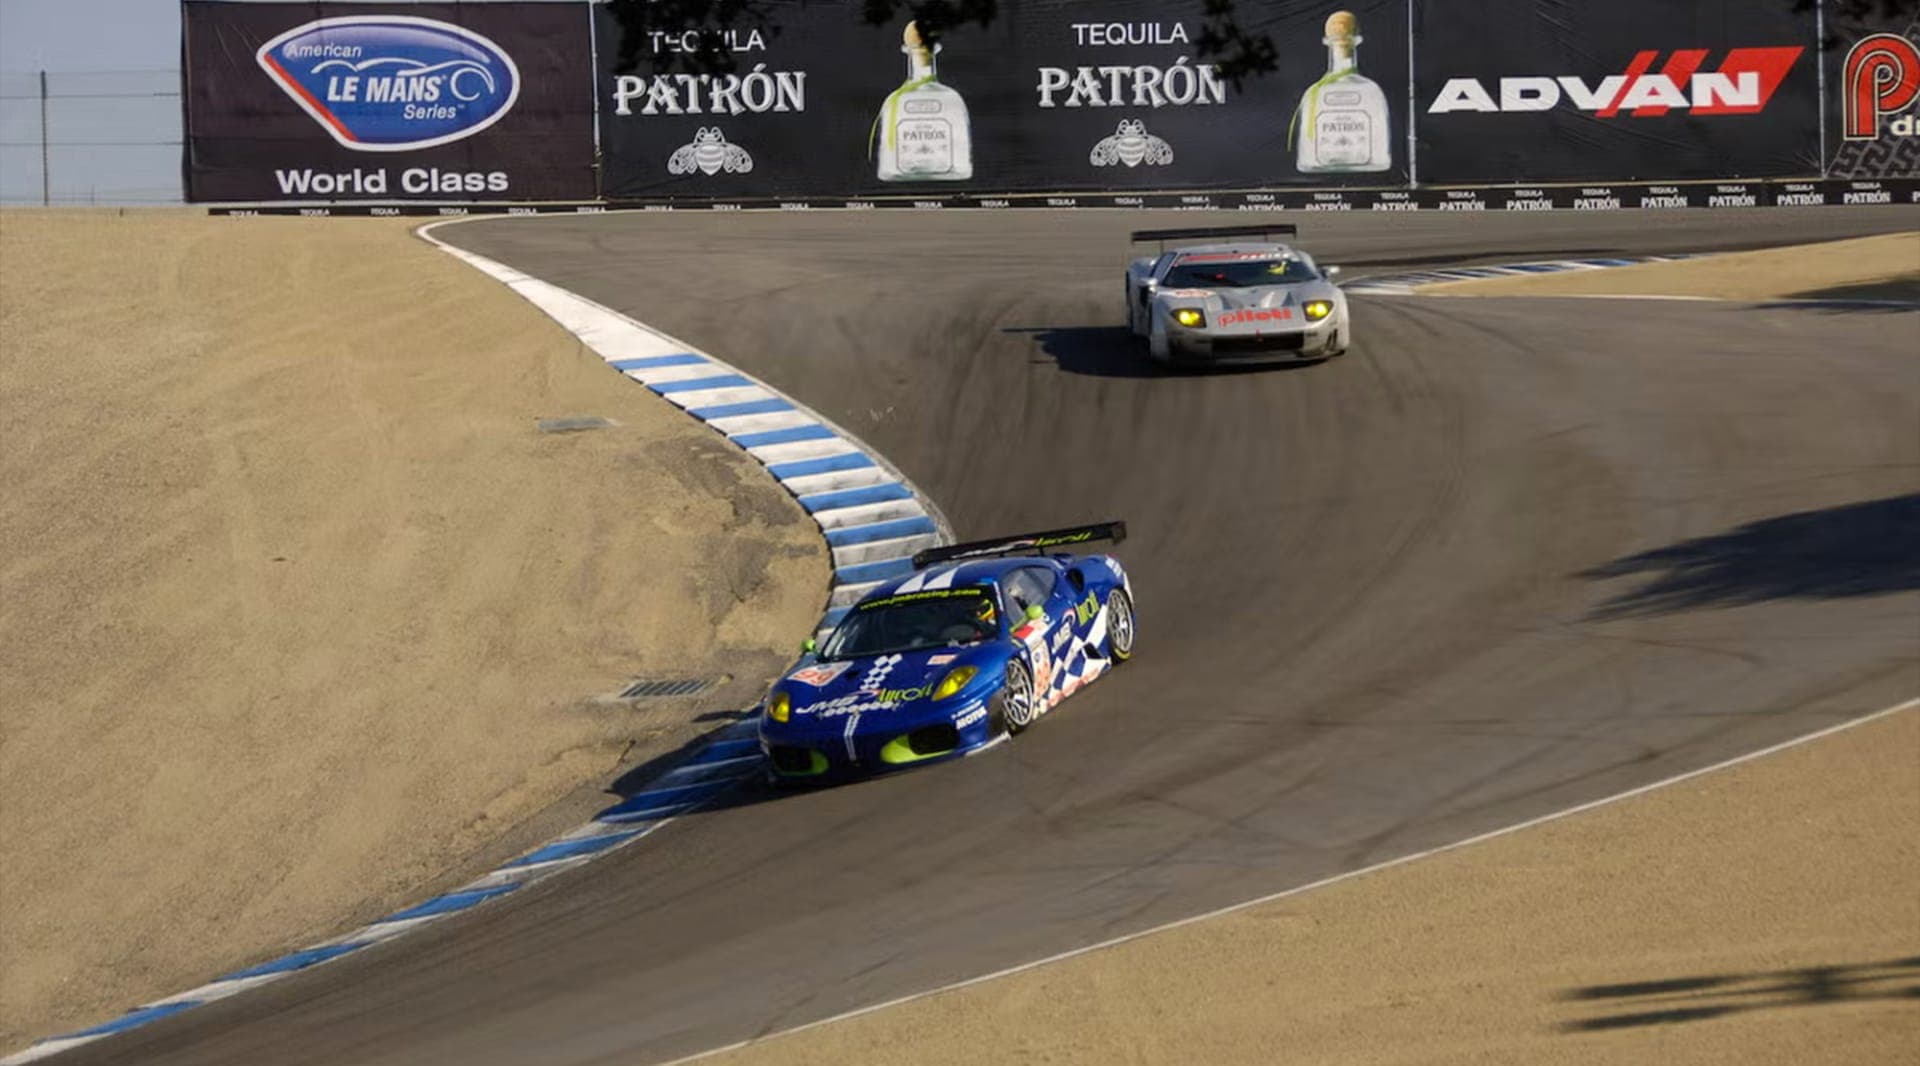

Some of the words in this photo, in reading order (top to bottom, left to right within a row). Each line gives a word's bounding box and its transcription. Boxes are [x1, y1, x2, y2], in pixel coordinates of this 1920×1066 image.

[647, 29, 767, 53] TEQILA
[1071, 22, 1189, 46] TEQUILA
[286, 43, 363, 59] American
[327, 76, 361, 102] LE
[364, 75, 442, 103] MANS
[612, 63, 807, 117] PATRÓN
[1036, 55, 1227, 109] PATRÓN
[1427, 71, 1761, 116] ADVAN
[403, 104, 457, 120] Series
[275, 169, 387, 195] World
[401, 167, 510, 193] Class
[1439, 198, 1486, 211] PATRÓN
[1506, 197, 1553, 210] PATRÓN
[1573, 195, 1620, 210] PATRÓN
[1641, 194, 1688, 209] PATRÓN
[1709, 192, 1756, 207] PATRÓN
[1776, 191, 1824, 206] PATRÓN
[1843, 189, 1891, 204] PATRÓN
